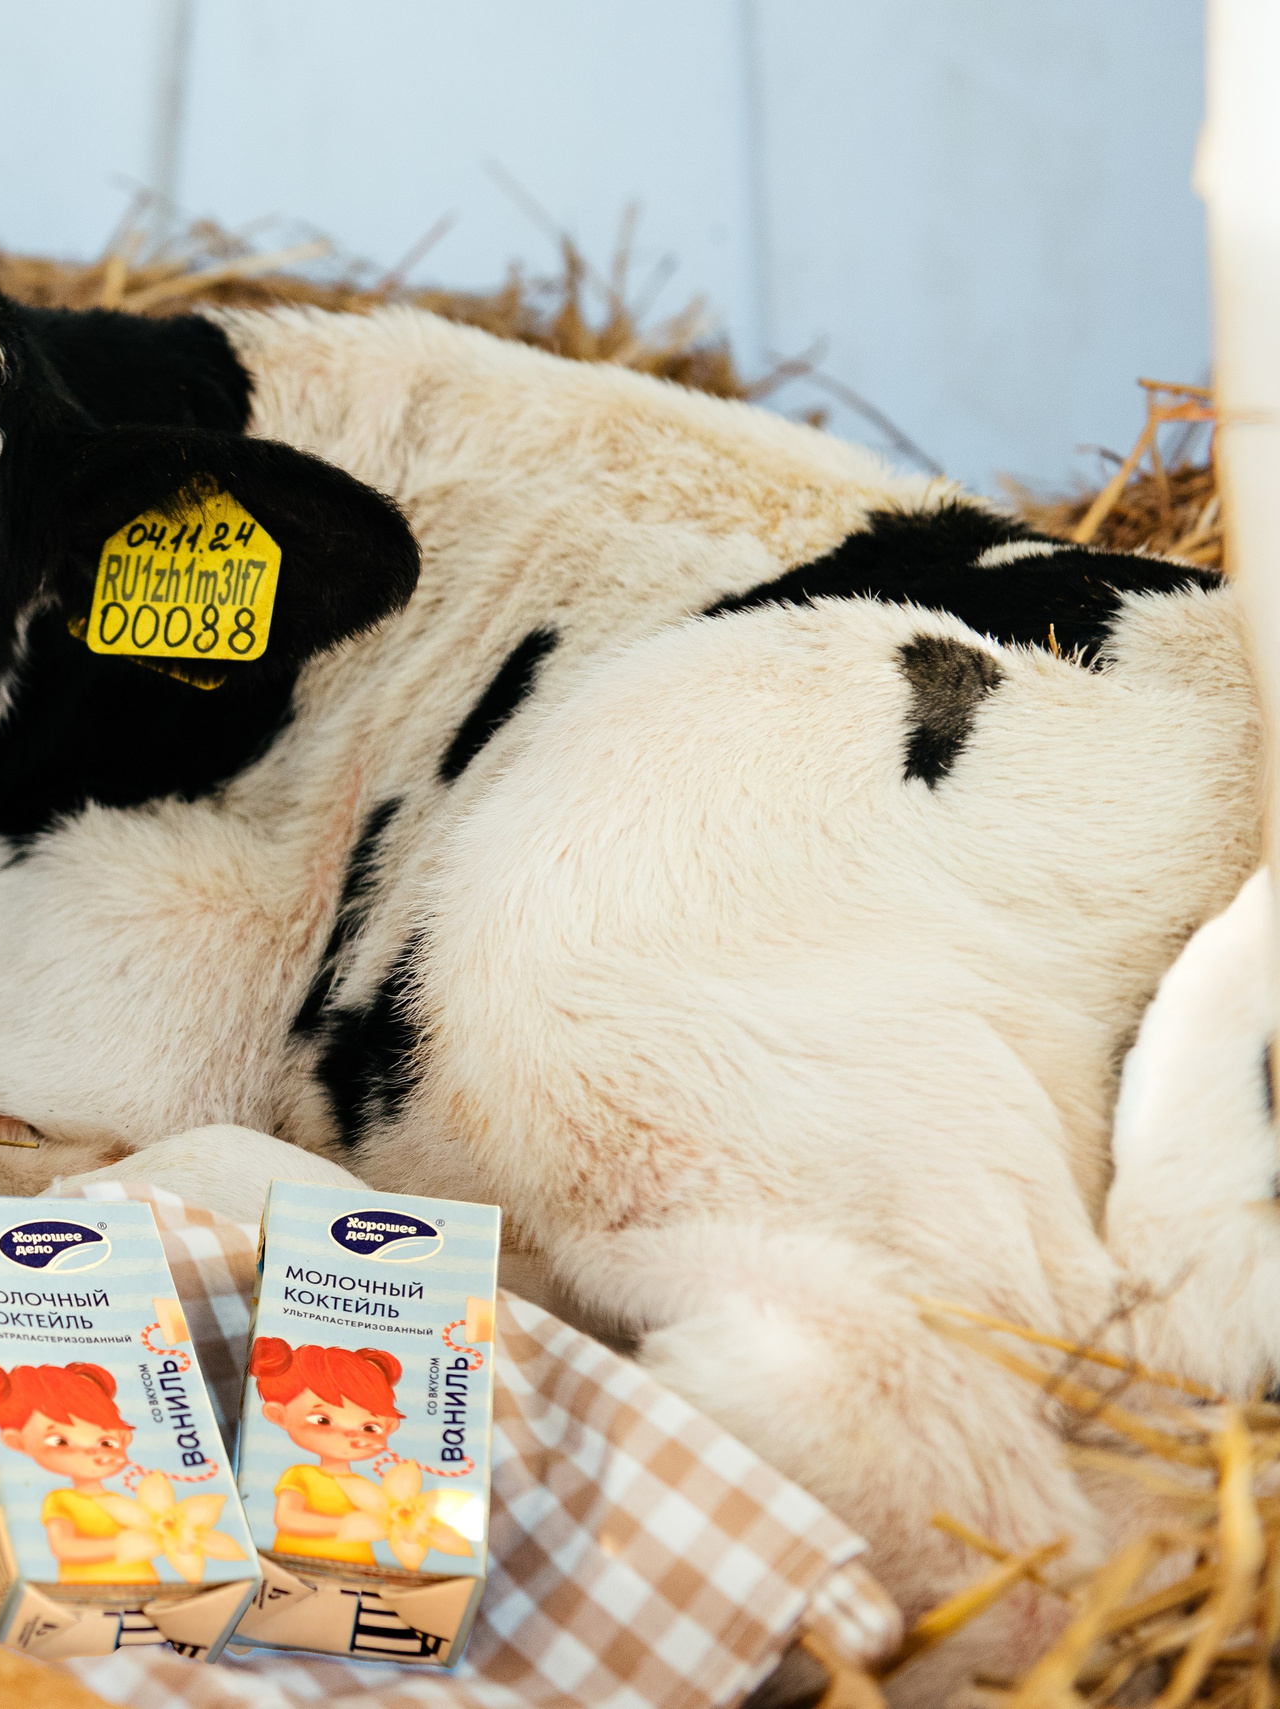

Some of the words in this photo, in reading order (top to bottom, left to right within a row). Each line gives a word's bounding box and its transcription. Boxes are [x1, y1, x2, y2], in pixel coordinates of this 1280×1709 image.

[347, 1217, 417, 1235] Хорошее
[11, 1231, 83, 1245] Хорошее
[345, 1231, 384, 1243] дело
[15, 1245, 53, 1256] дело
[285, 1265, 424, 1300] МОЛОЧНЫЙ
[284, 1286, 400, 1319] КОКТЕЙЛЬ
[282, 1307, 434, 1336] УЛЬТРАПАСТЕРИЗОВАННЫЙ
[138, 1363, 159, 1406] ВКУСОМ
[428, 1357, 440, 1399] ВКУСОМ
[151, 1408, 164, 1423] СО
[427, 1400, 438, 1416] СО
